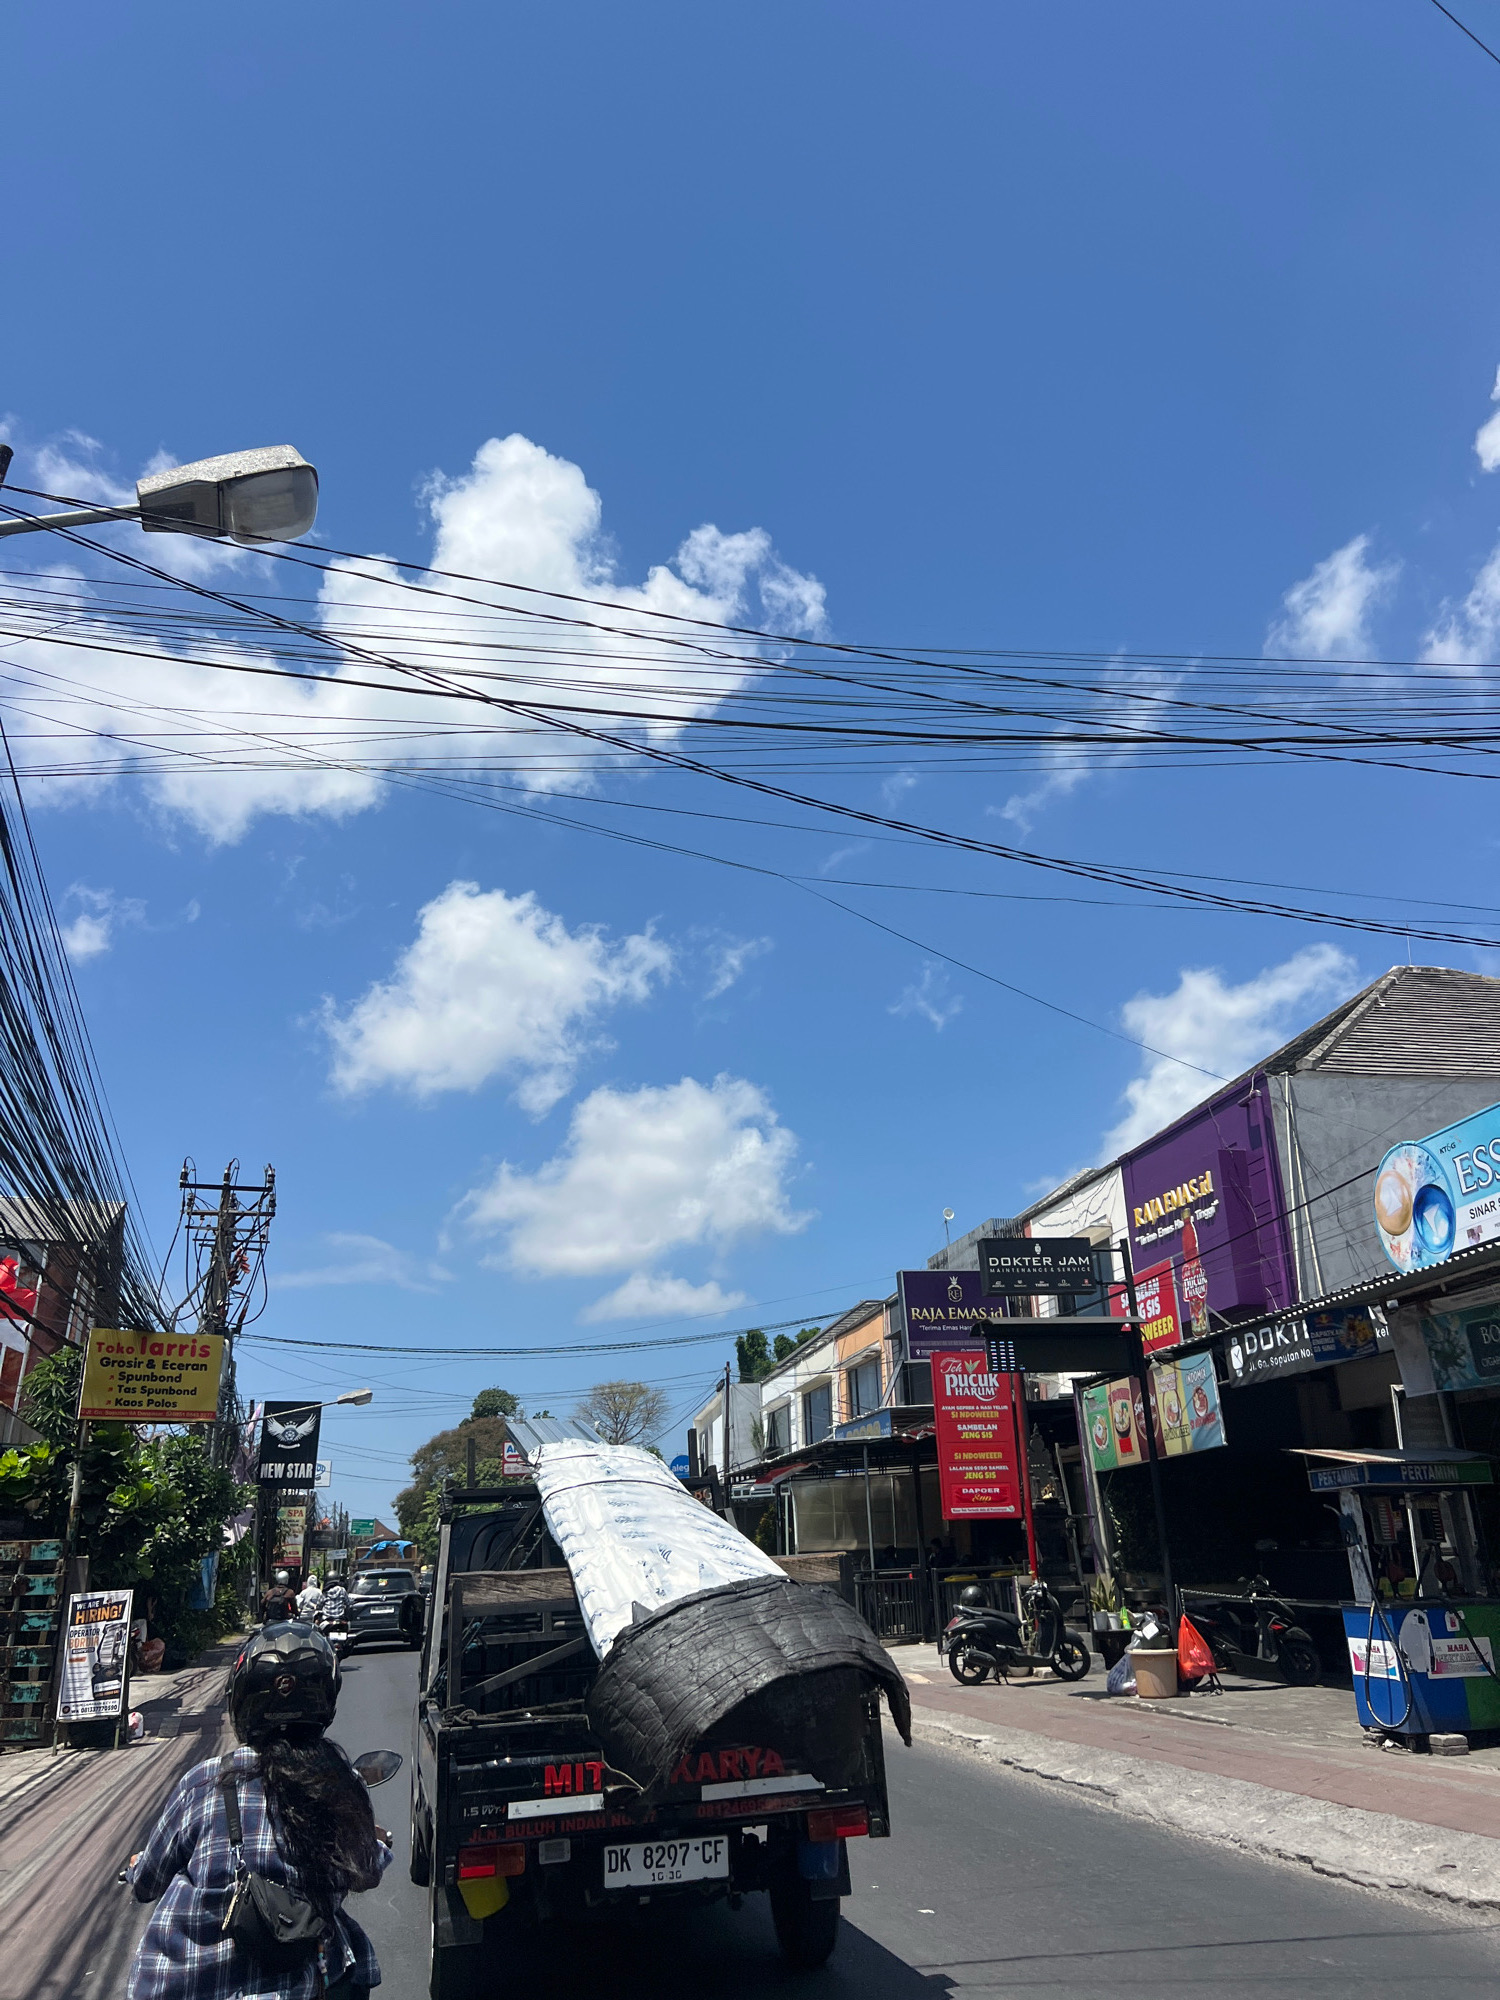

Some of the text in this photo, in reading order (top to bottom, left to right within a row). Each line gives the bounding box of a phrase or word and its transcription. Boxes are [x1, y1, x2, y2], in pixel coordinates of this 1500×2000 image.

[1133, 1197, 1166, 1228] RAJA
[1469, 1200, 1496, 1220] SINAR
[988, 1256, 1090, 1267] DOKTER JAM
[1146, 1296, 1161, 1319] SIS
[911, 1307, 946, 1323] RAJA
[96, 1341, 135, 1354] Toko
[100, 1356, 208, 1371] Grosir & Eceran
[940, 1359, 962, 1374] Teh
[1270, 1353, 1300, 1368] Soputan
[118, 1371, 182, 1383] Spunbond
[117, 1384, 197, 1397] Tas Spunbond
[955, 1387, 997, 1400] HARUM
[115, 1398, 178, 1408] Kaos Polos
[951, 1411, 959, 1419] SI
[961, 1431, 993, 1439] JENG SIS
[954, 1452, 961, 1460] SI
[260, 1463, 285, 1479] NEW
[286, 1463, 313, 1479] STAR
[964, 1471, 996, 1479] JENG SIS
[1400, 1464, 1459, 1481] PERTAMINI
[87, 1600, 100, 1609] ARE
[76, 1604, 123, 1625] HIRING!
[70, 1628, 100, 1638] OPERATOR
[670, 1747, 786, 1784] KARYA
[463, 1807, 478, 1817] 1.5
[469, 1827, 500, 1843] JLN.
[505, 1821, 556, 1839] BULUH
[560, 1815, 607, 1833] INDAH
[607, 1839, 724, 1873] DK 8297 CF
